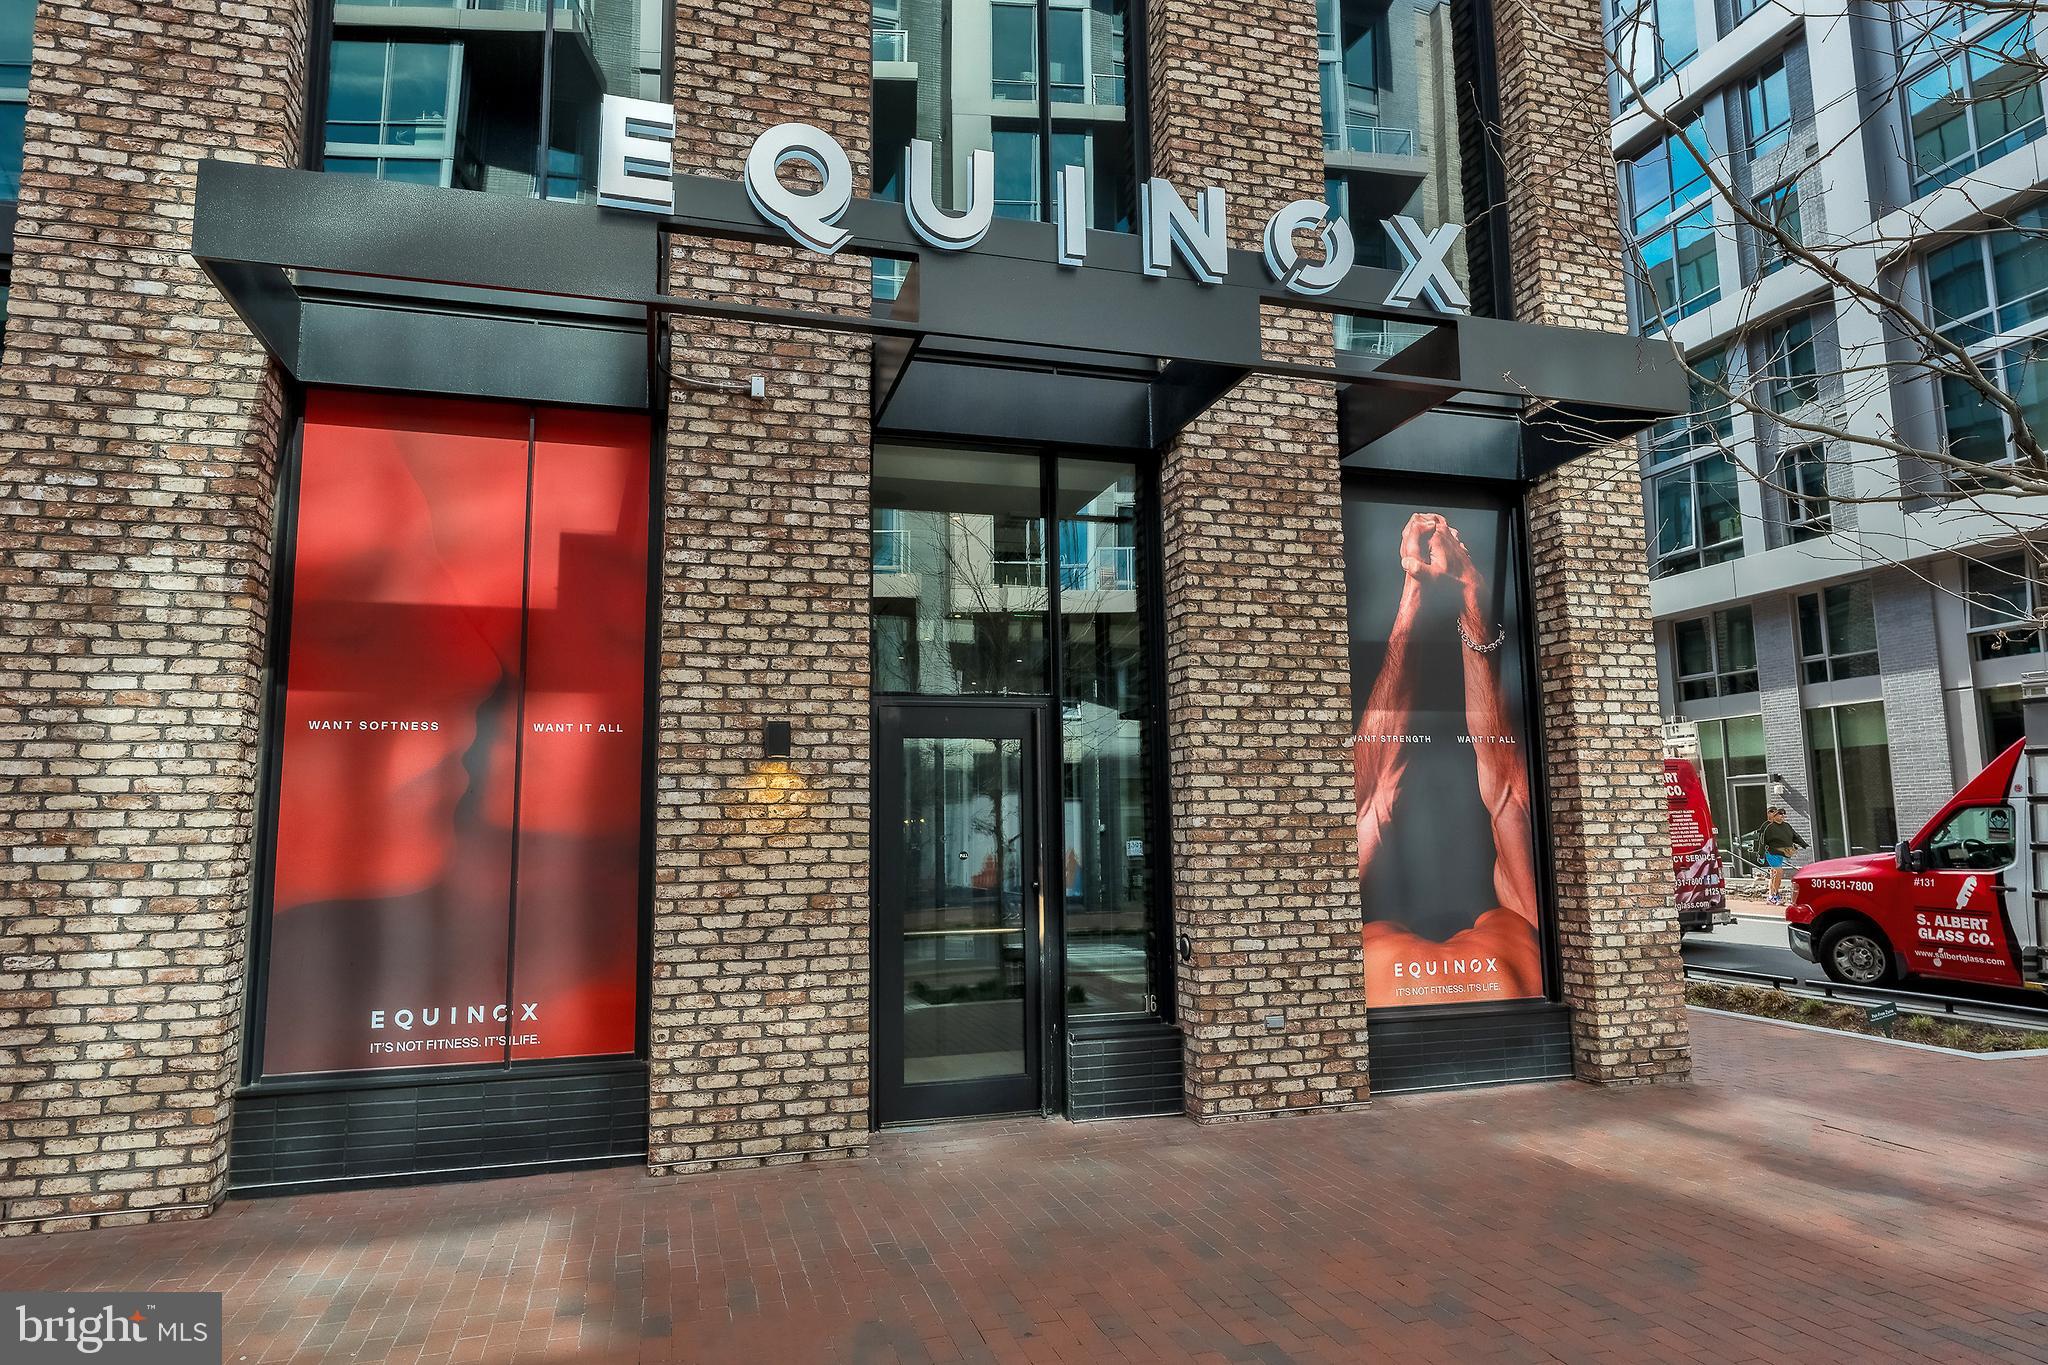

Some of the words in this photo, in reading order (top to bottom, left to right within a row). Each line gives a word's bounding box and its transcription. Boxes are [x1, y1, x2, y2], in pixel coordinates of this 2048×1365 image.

[597, 94, 1471, 316] EQUINOX
[308, 720, 352, 730] WANT
[358, 721, 440, 731] SOFTNESS
[533, 723, 574, 733] WANT
[578, 723, 593, 733] IT
[598, 723, 624, 733] ALL
[1380, 735, 1432, 743] STRENGTH
[1456, 735, 1484, 743] WANT
[1499, 736, 1516, 744] ALL
[1811, 878, 1874, 892] 301-931-7800
[1913, 877, 1935, 887] #131
[1916, 913, 1931, 926] S.
[1934, 915, 1989, 931] ALBERT
[1918, 927, 1965, 943] GLASS
[1968, 932, 1995, 946] CO.
[1394, 957, 1498, 979] EQUINOX
[1412, 986, 1429, 996] NOT
[1430, 984, 1466, 994] FITNESS.
[1482, 982, 1501, 991] LIFE.
[1144, 994, 1157, 1013] 16
[370, 1002, 539, 1031] EQUINOX
[396, 1040, 424, 1053] NOT
[426, 1036, 482, 1051] FITNESS.
